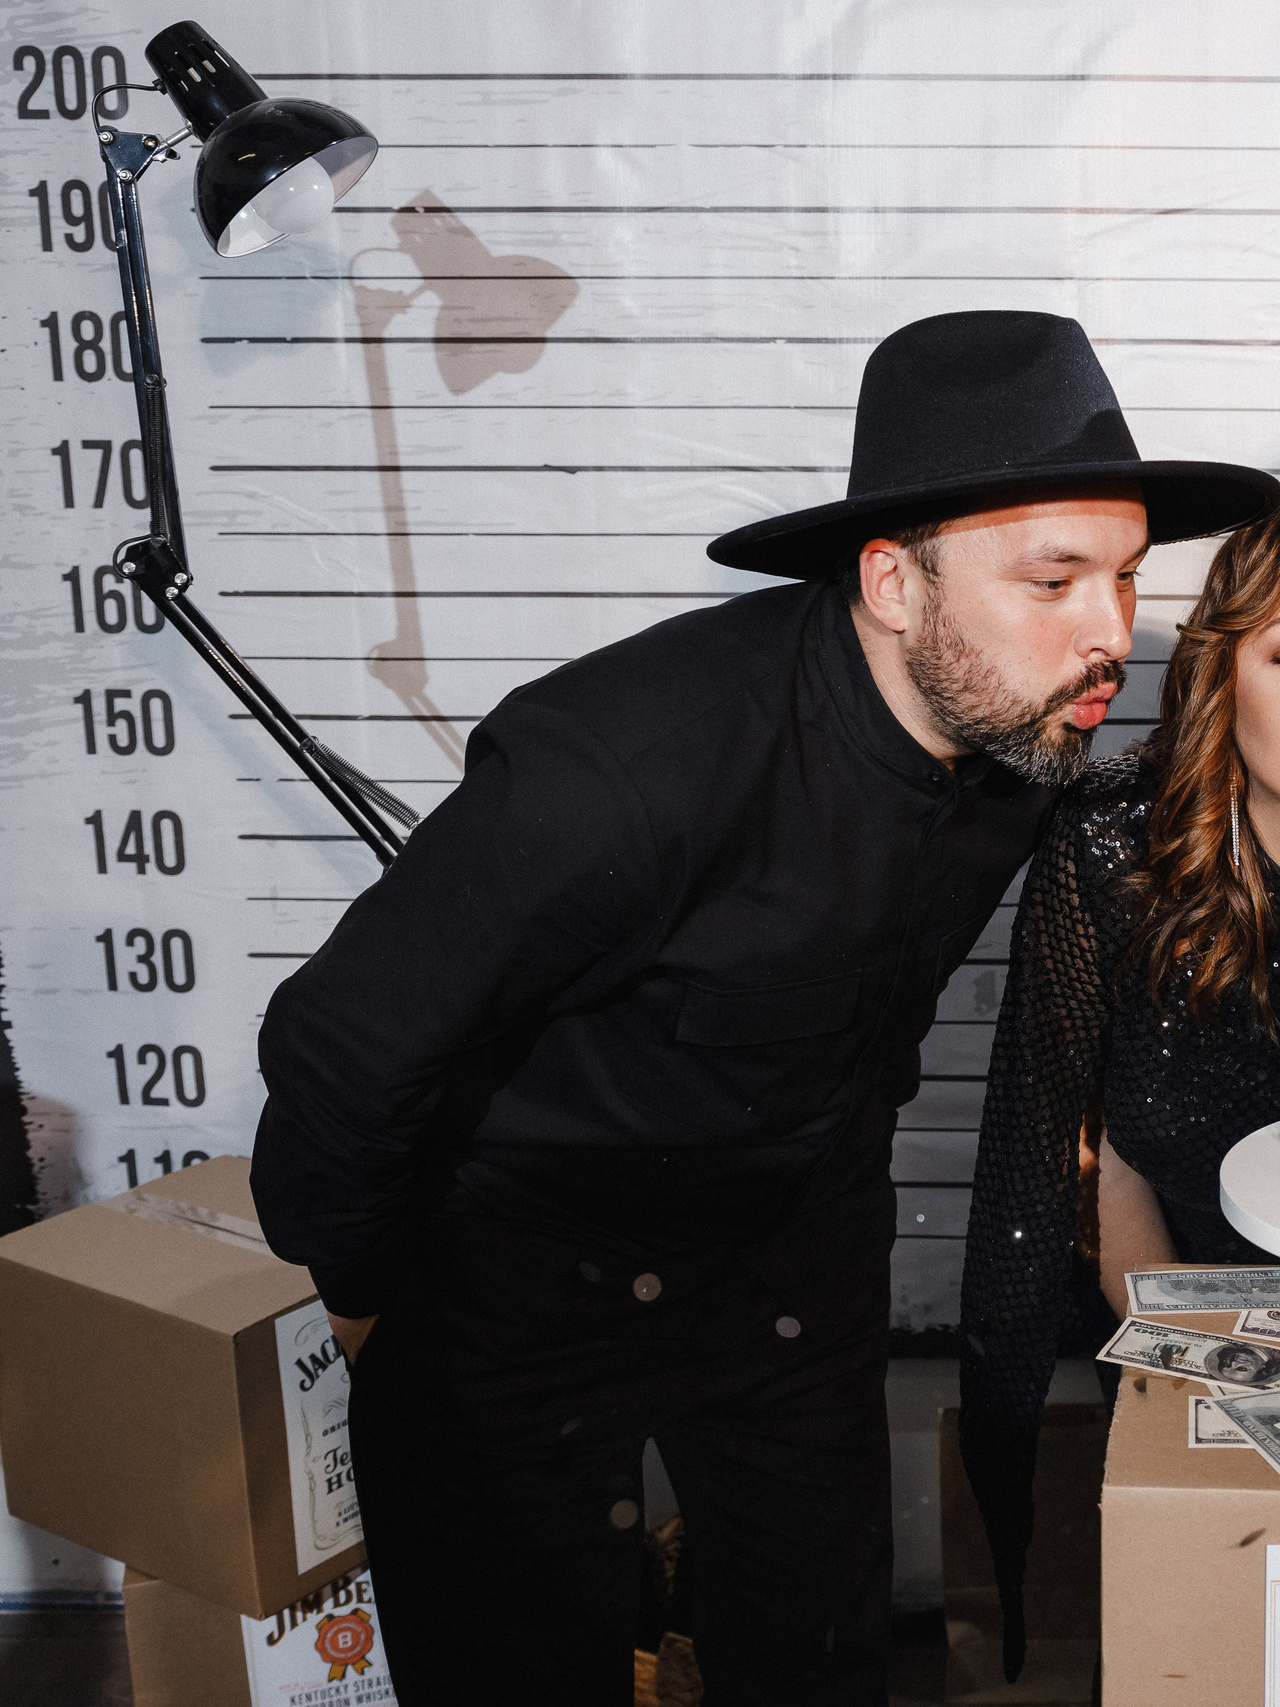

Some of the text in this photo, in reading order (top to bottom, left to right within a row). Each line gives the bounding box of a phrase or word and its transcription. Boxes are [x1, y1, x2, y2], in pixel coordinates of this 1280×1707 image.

[12, 45, 130, 121] 200
[51, 440, 151, 509] 170
[62, 565, 166, 634] 160
[74, 688, 176, 756] 150
[84, 810, 186, 875] 140
[95, 928, 195, 993] 130
[106, 1043, 206, 1108] 120
[331, 1572, 373, 1610] BE
[338, 1631, 352, 1649] B
[289, 1683, 349, 1706] KENTUCKY
[353, 1675, 393, 1693] STRAI
[355, 1687, 396, 1705] WHISK
